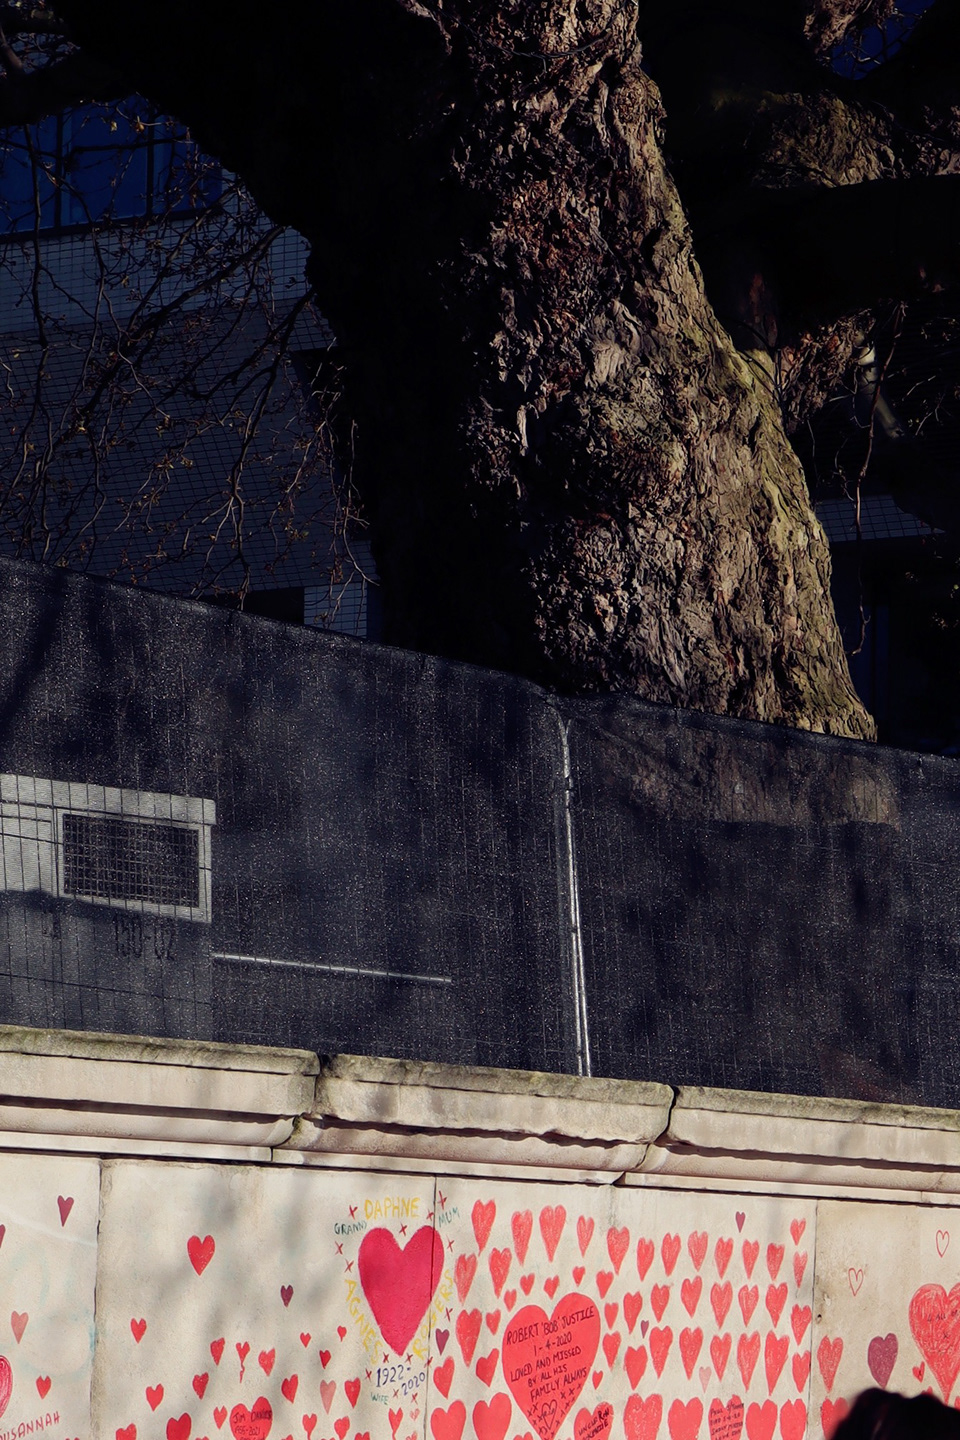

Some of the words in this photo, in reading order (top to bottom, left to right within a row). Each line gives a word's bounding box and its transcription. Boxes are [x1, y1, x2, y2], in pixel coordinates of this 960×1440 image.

[364, 1197, 421, 1220] DAPHNE
[438, 1206, 460, 1228] MUM
[345, 1279, 383, 1366] AGNES
[412, 1269, 454, 1361] ROGERS
[506, 1322, 541, 1346] ROBERT
[561, 1305, 595, 1330] JUSTICE
[510, 1362, 533, 1383] LOVED
[535, 1356, 551, 1371] AND
[552, 1345, 583, 1363] MISSED
[540, 1370, 552, 1381] ALL
[553, 1363, 568, 1376] HIS
[401, 1371, 426, 1397] 2020
[529, 1379, 560, 1403] FAMILY
[563, 1366, 588, 1388] ALWAYS
